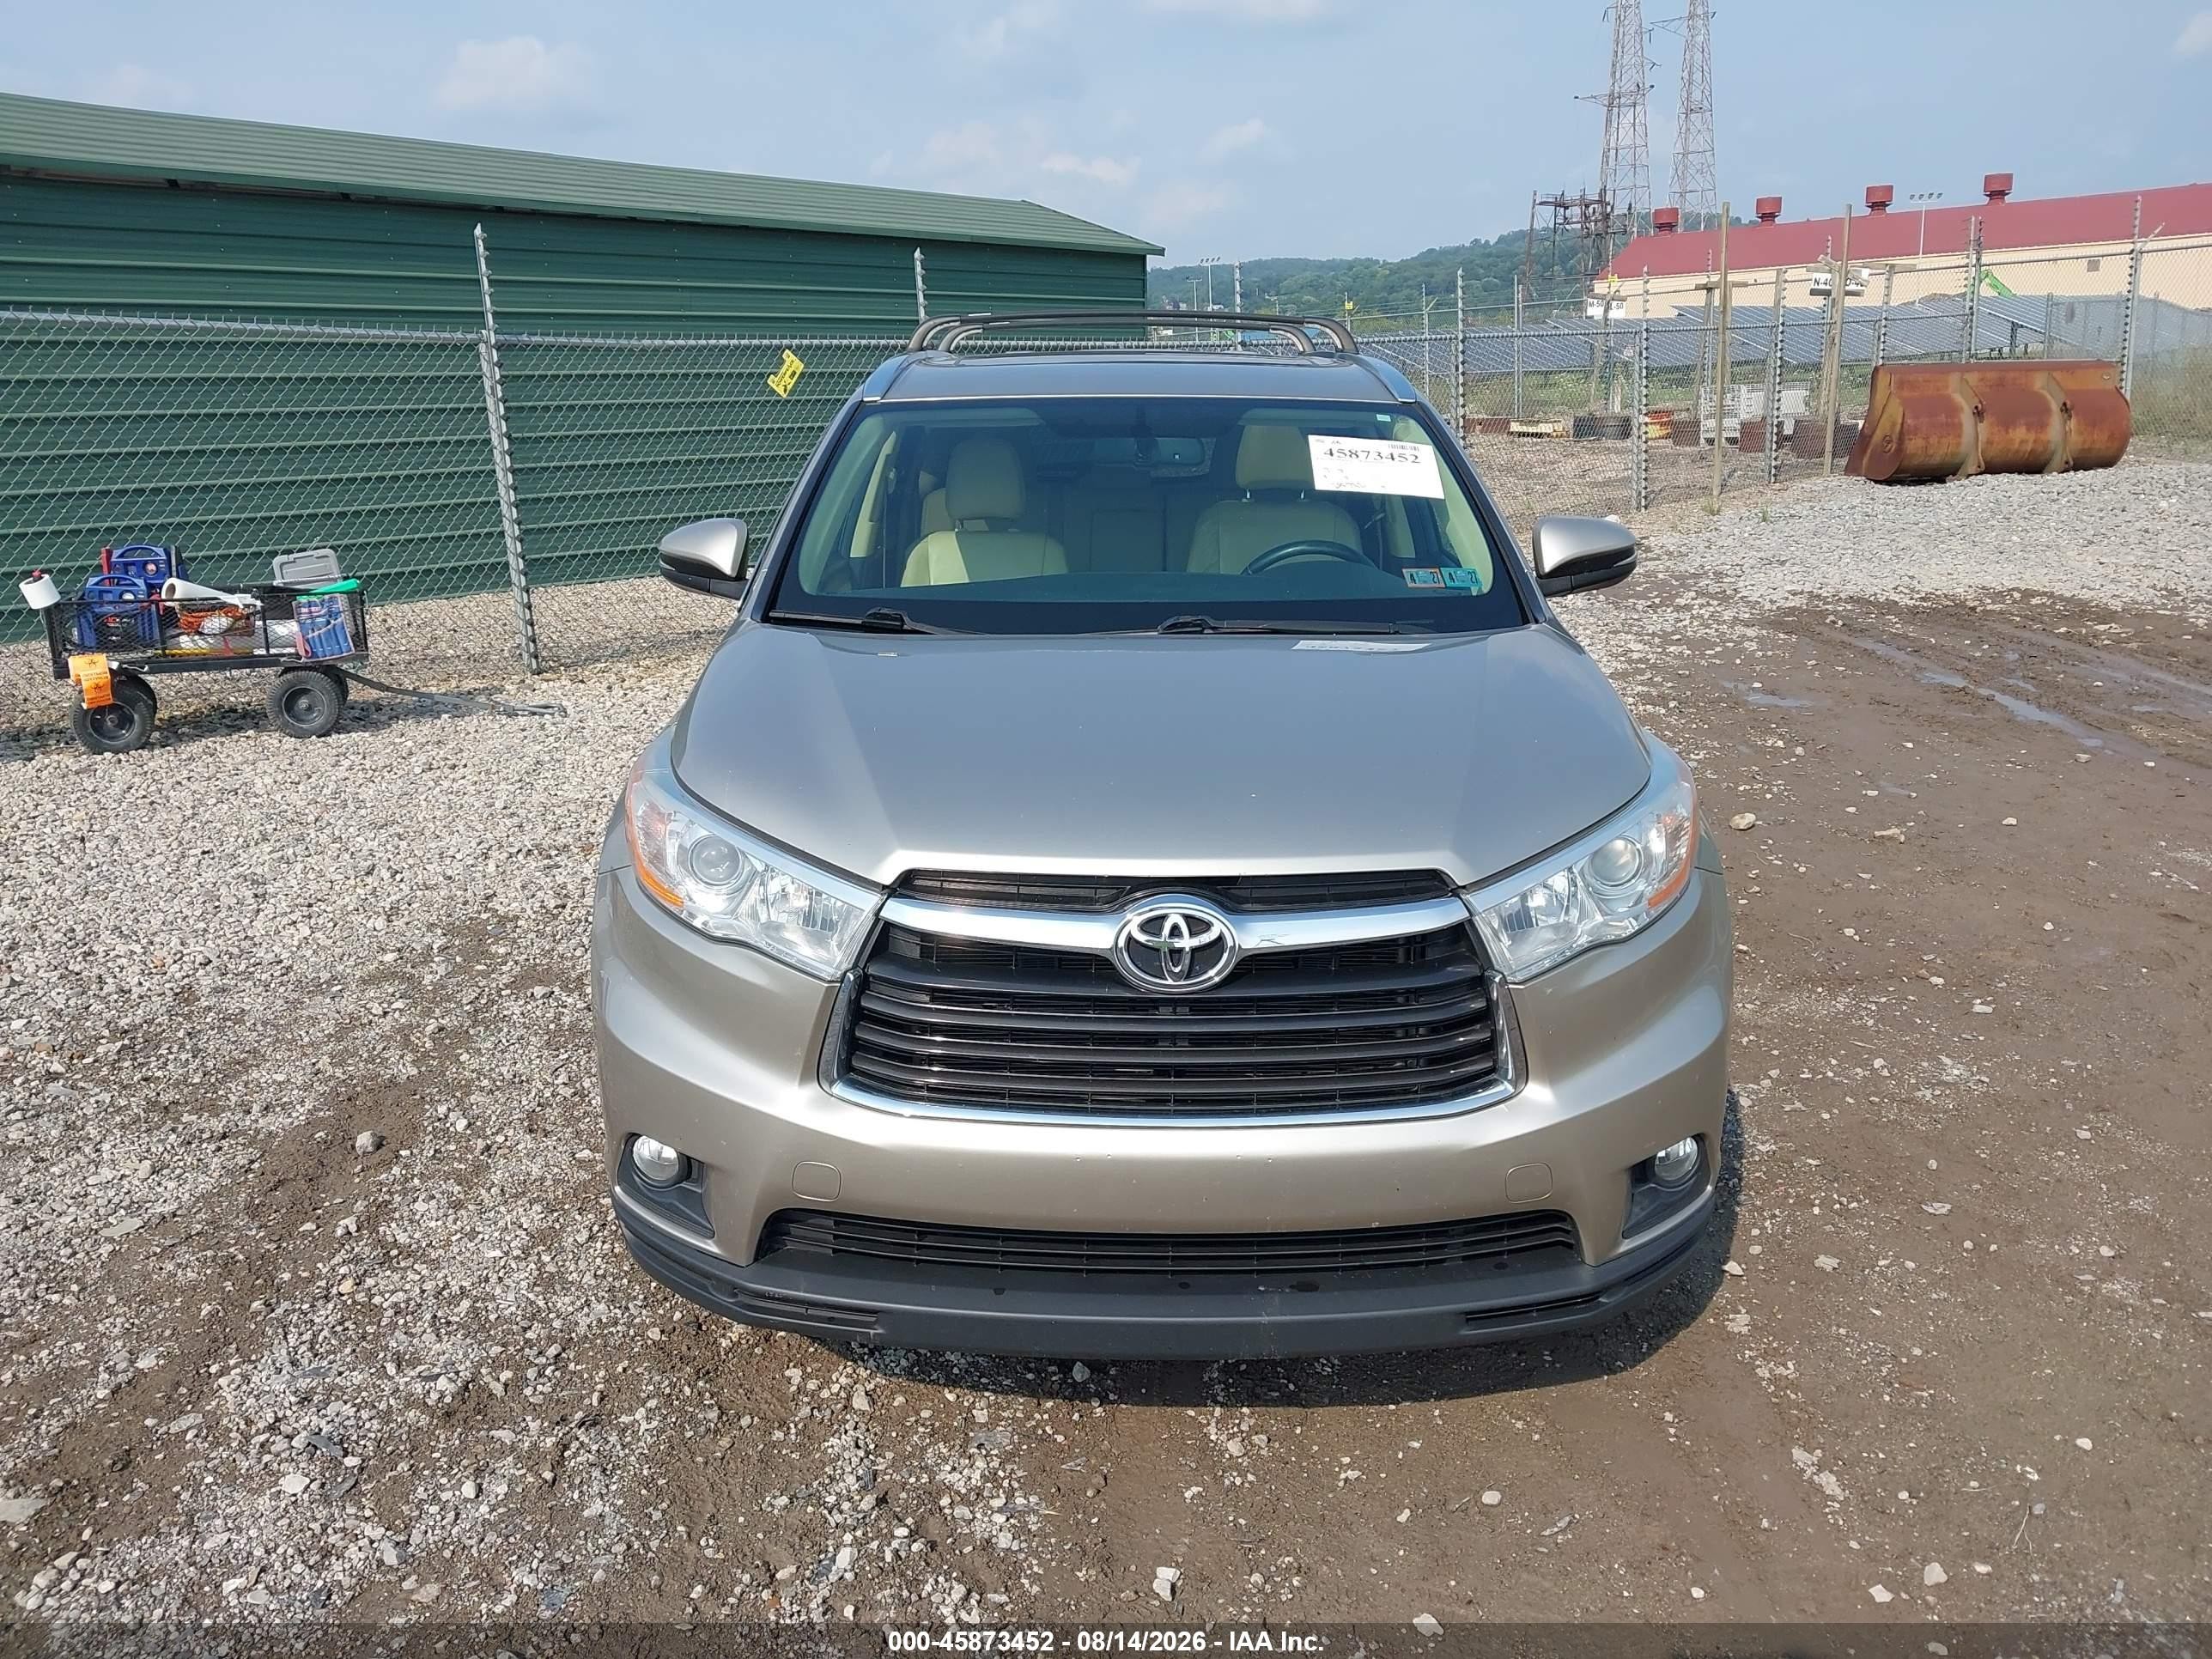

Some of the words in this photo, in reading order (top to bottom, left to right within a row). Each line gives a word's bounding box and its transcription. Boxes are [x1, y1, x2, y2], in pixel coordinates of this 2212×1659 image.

[1814, 277, 1832, 287] N-40
[1323, 447, 1421, 464] 45873452
[1409, 573, 1417, 585] 4
[1448, 572, 1455, 584] 4
